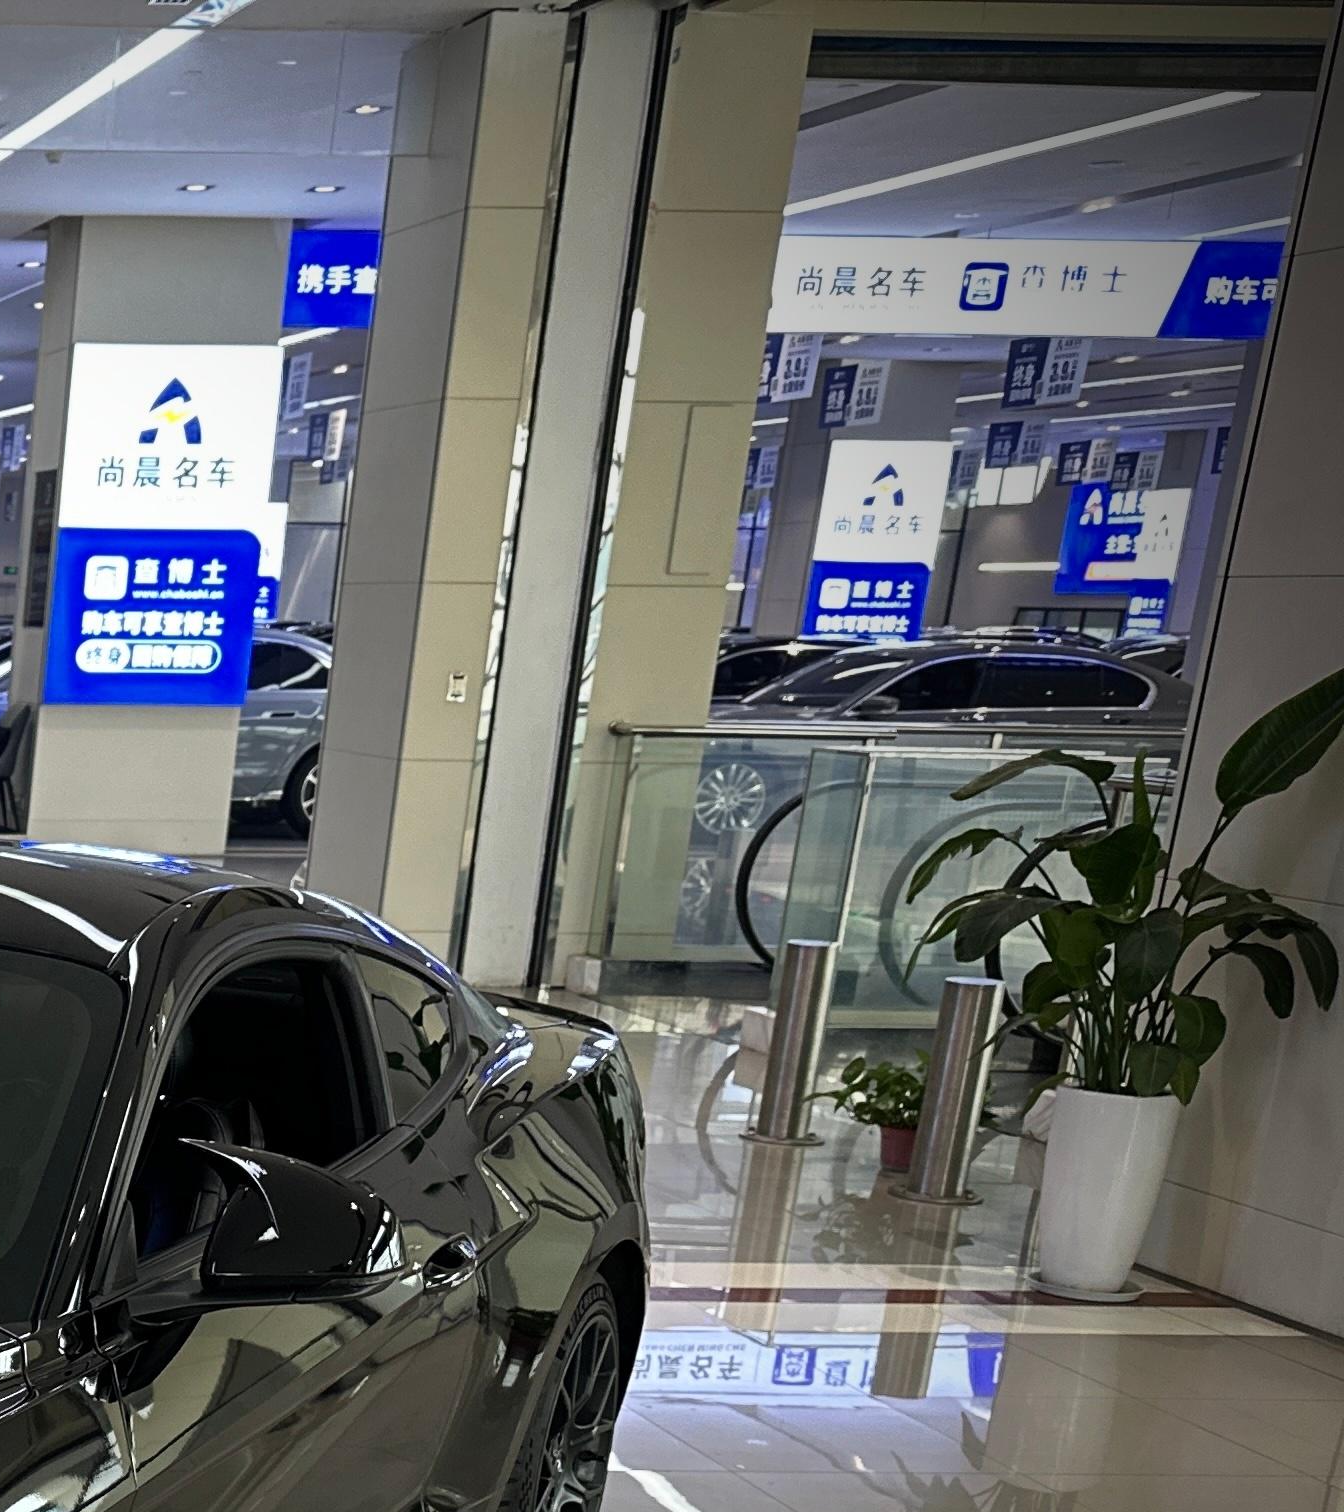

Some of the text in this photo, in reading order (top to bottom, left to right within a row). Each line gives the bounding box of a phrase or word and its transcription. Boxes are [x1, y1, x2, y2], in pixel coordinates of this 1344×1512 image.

[796, 265, 928, 297] 尚晨名车
[97, 456, 236, 488] 尚晨名车
